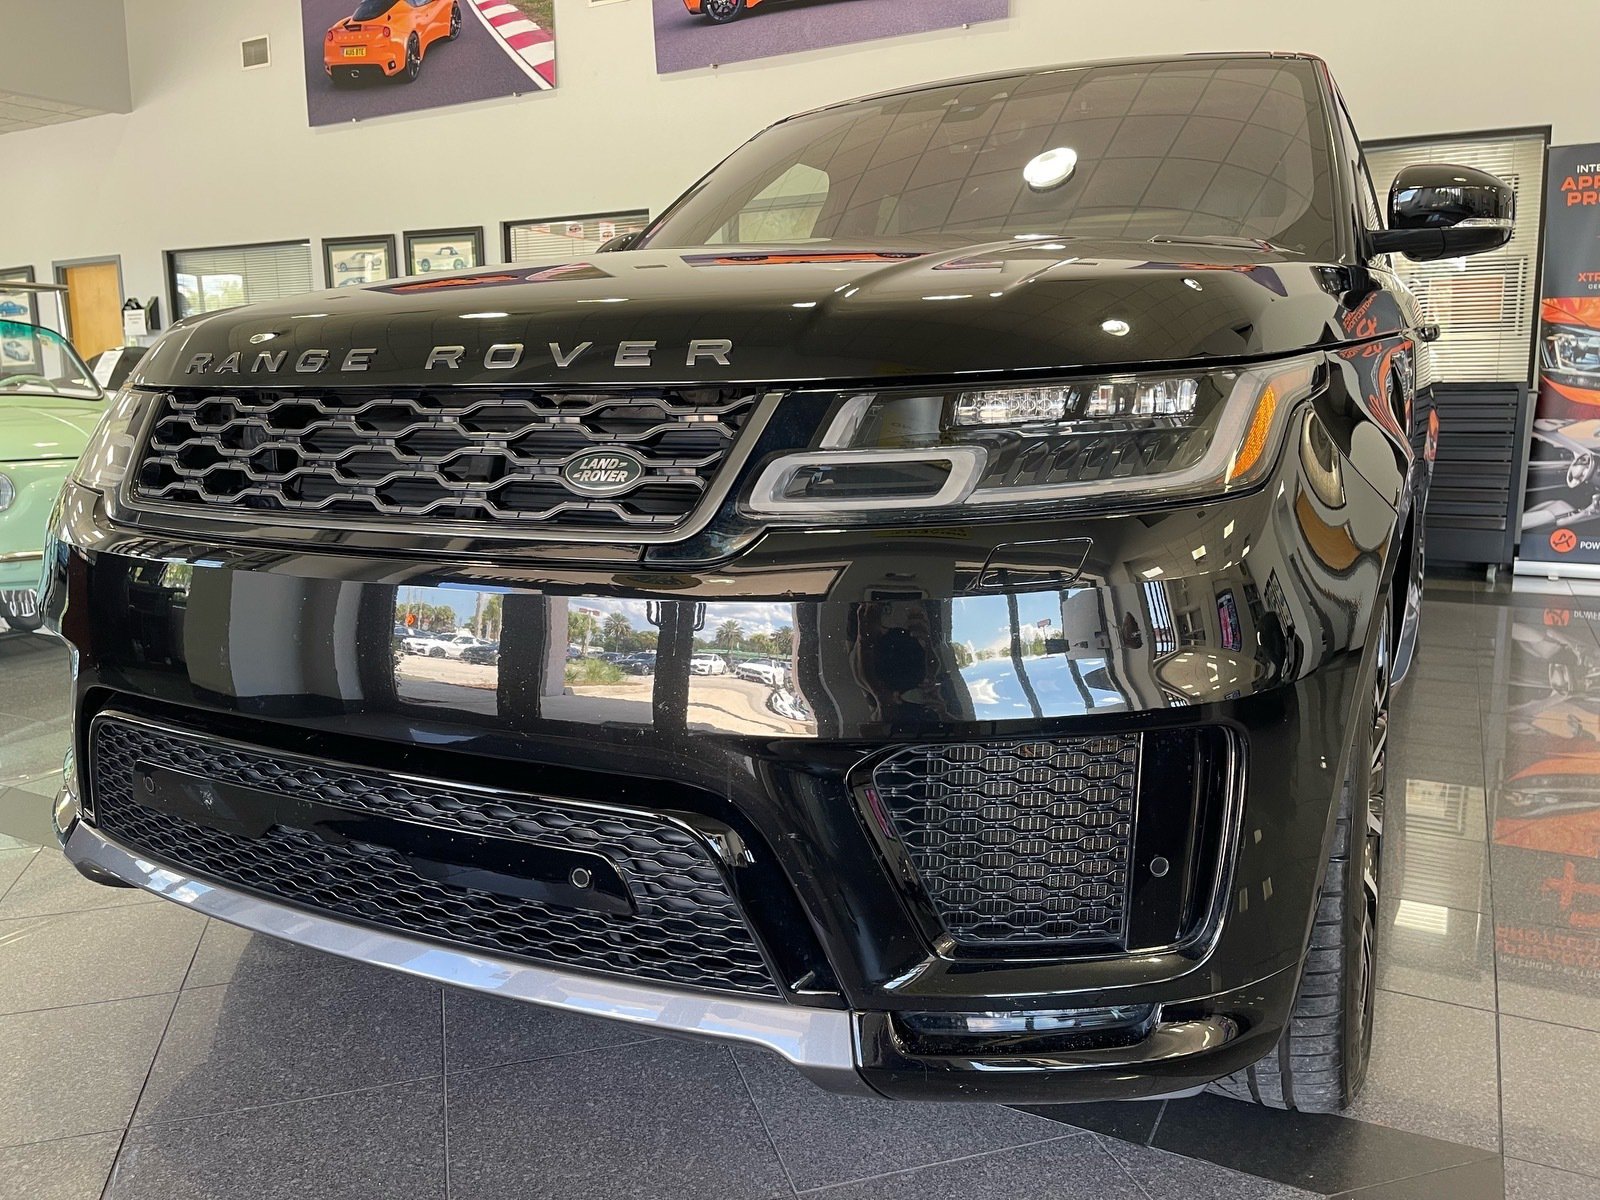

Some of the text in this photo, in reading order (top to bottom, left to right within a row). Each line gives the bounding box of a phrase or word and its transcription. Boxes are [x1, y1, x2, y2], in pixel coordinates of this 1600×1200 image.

[1567, 191, 1600, 206] PR
[184, 338, 734, 375] RANGE ROVER
[579, 458, 621, 470] LAND
[579, 470, 628, 482] ROVER
